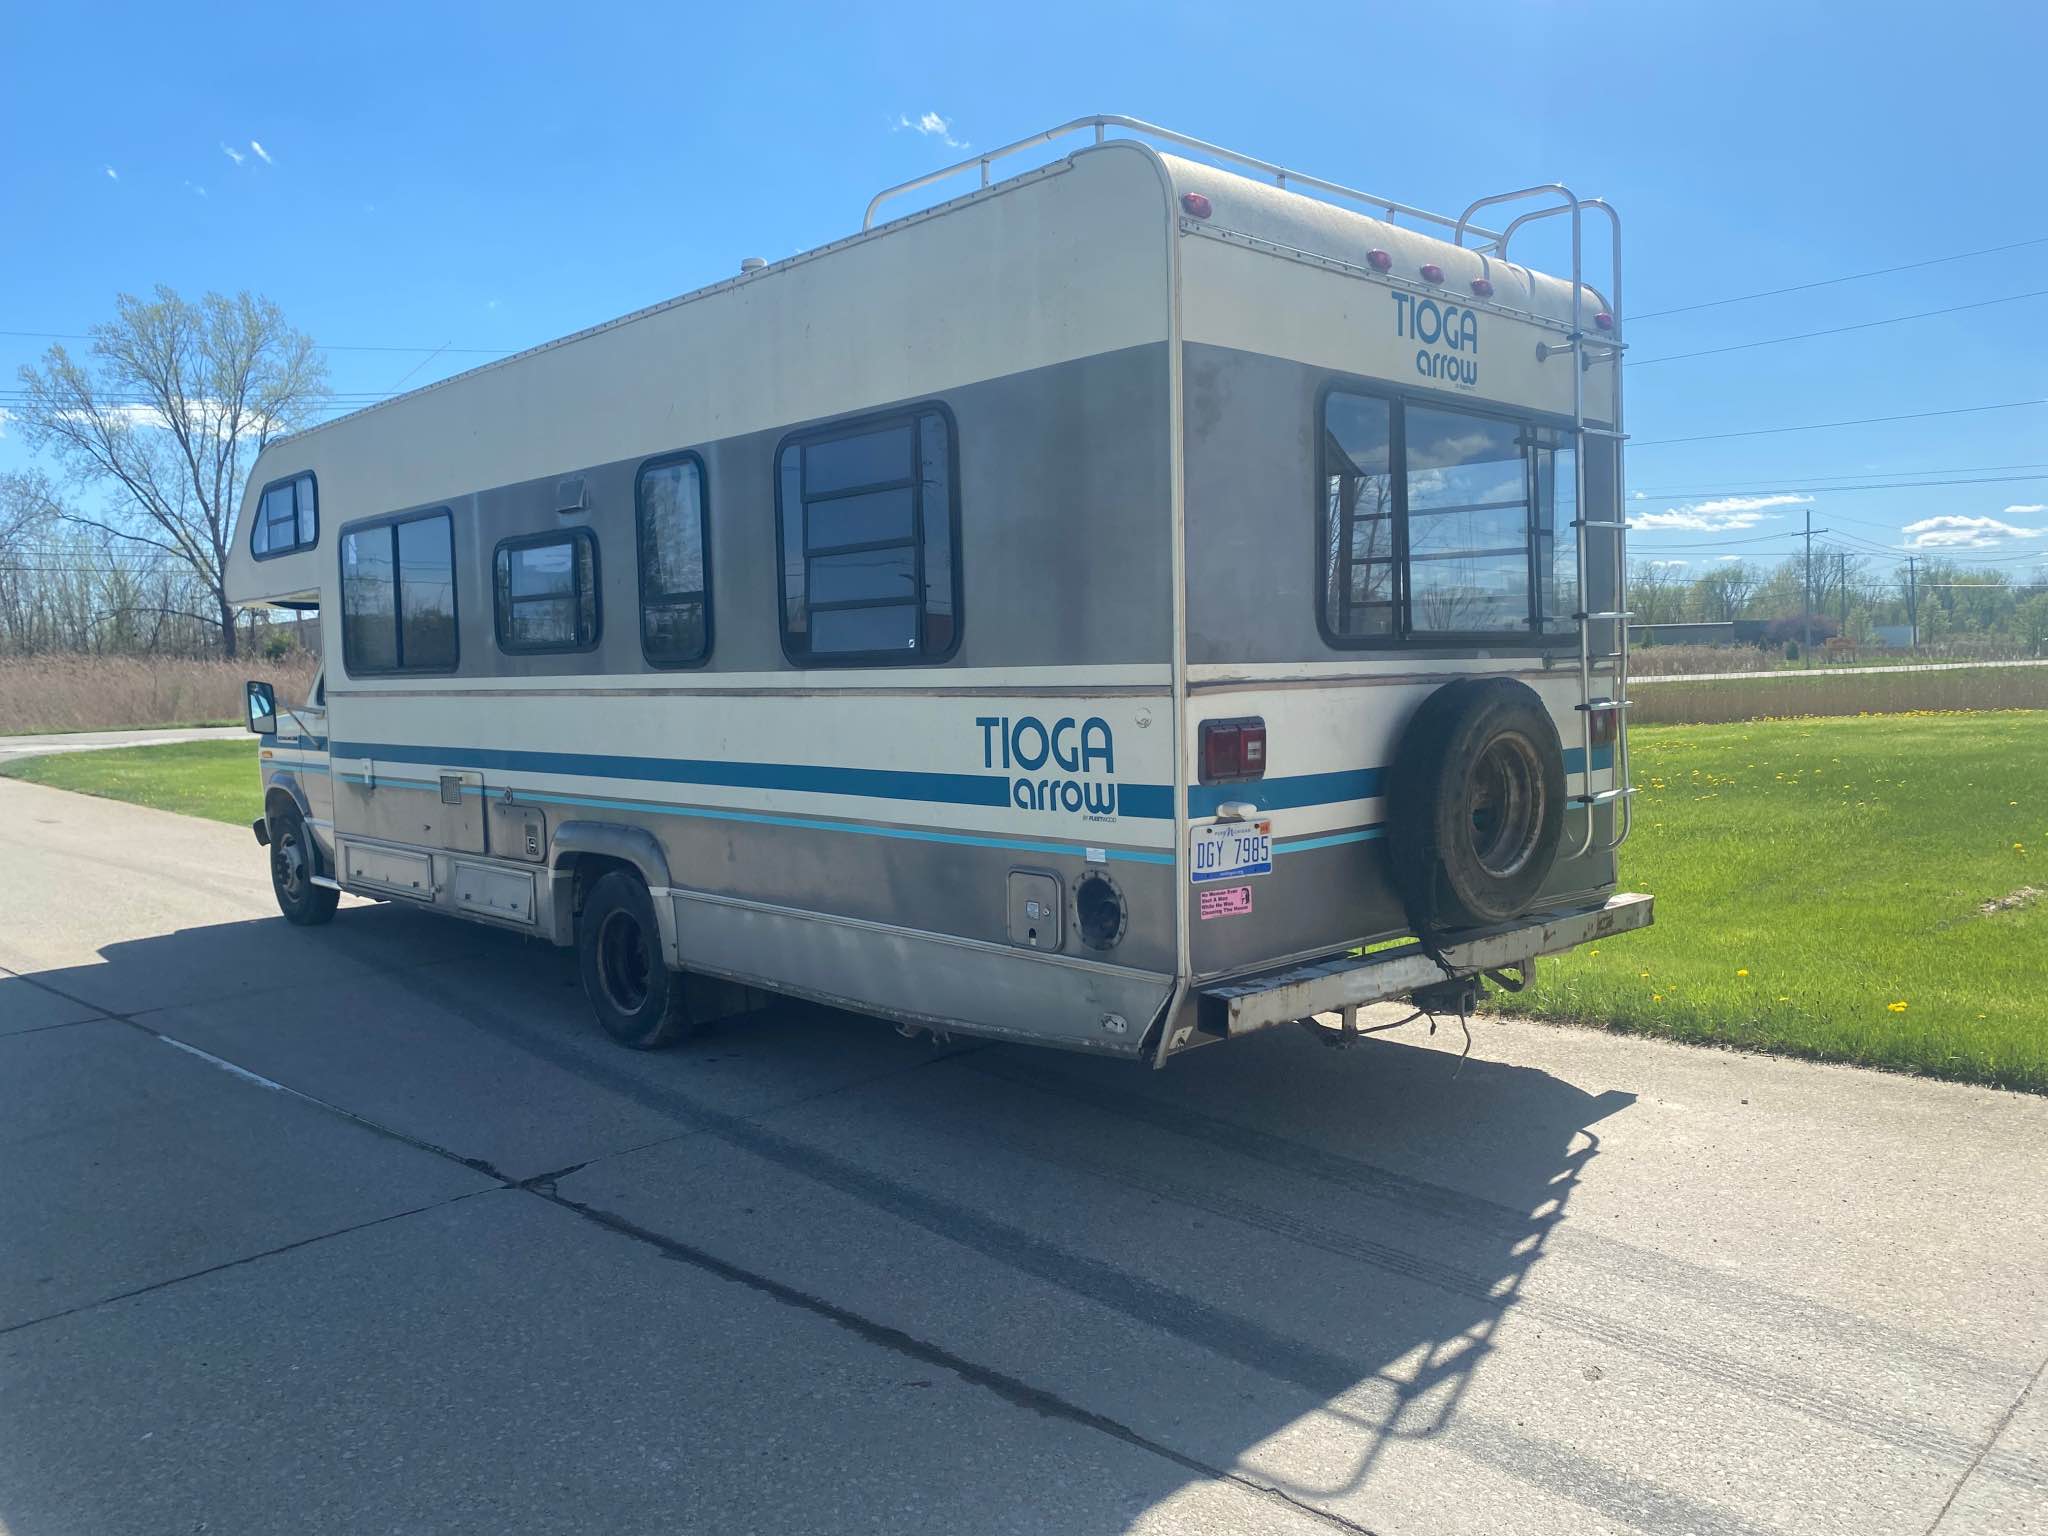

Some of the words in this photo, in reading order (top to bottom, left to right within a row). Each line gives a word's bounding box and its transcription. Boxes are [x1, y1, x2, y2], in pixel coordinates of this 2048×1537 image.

[1392, 291, 1478, 354] TIOGA
[1416, 349, 1478, 385] arrow
[976, 717, 1114, 774] TIOGA
[1013, 778, 1116, 815] arrow
[1197, 840, 1223, 869] DGY
[1234, 836, 1269, 864] 7985
